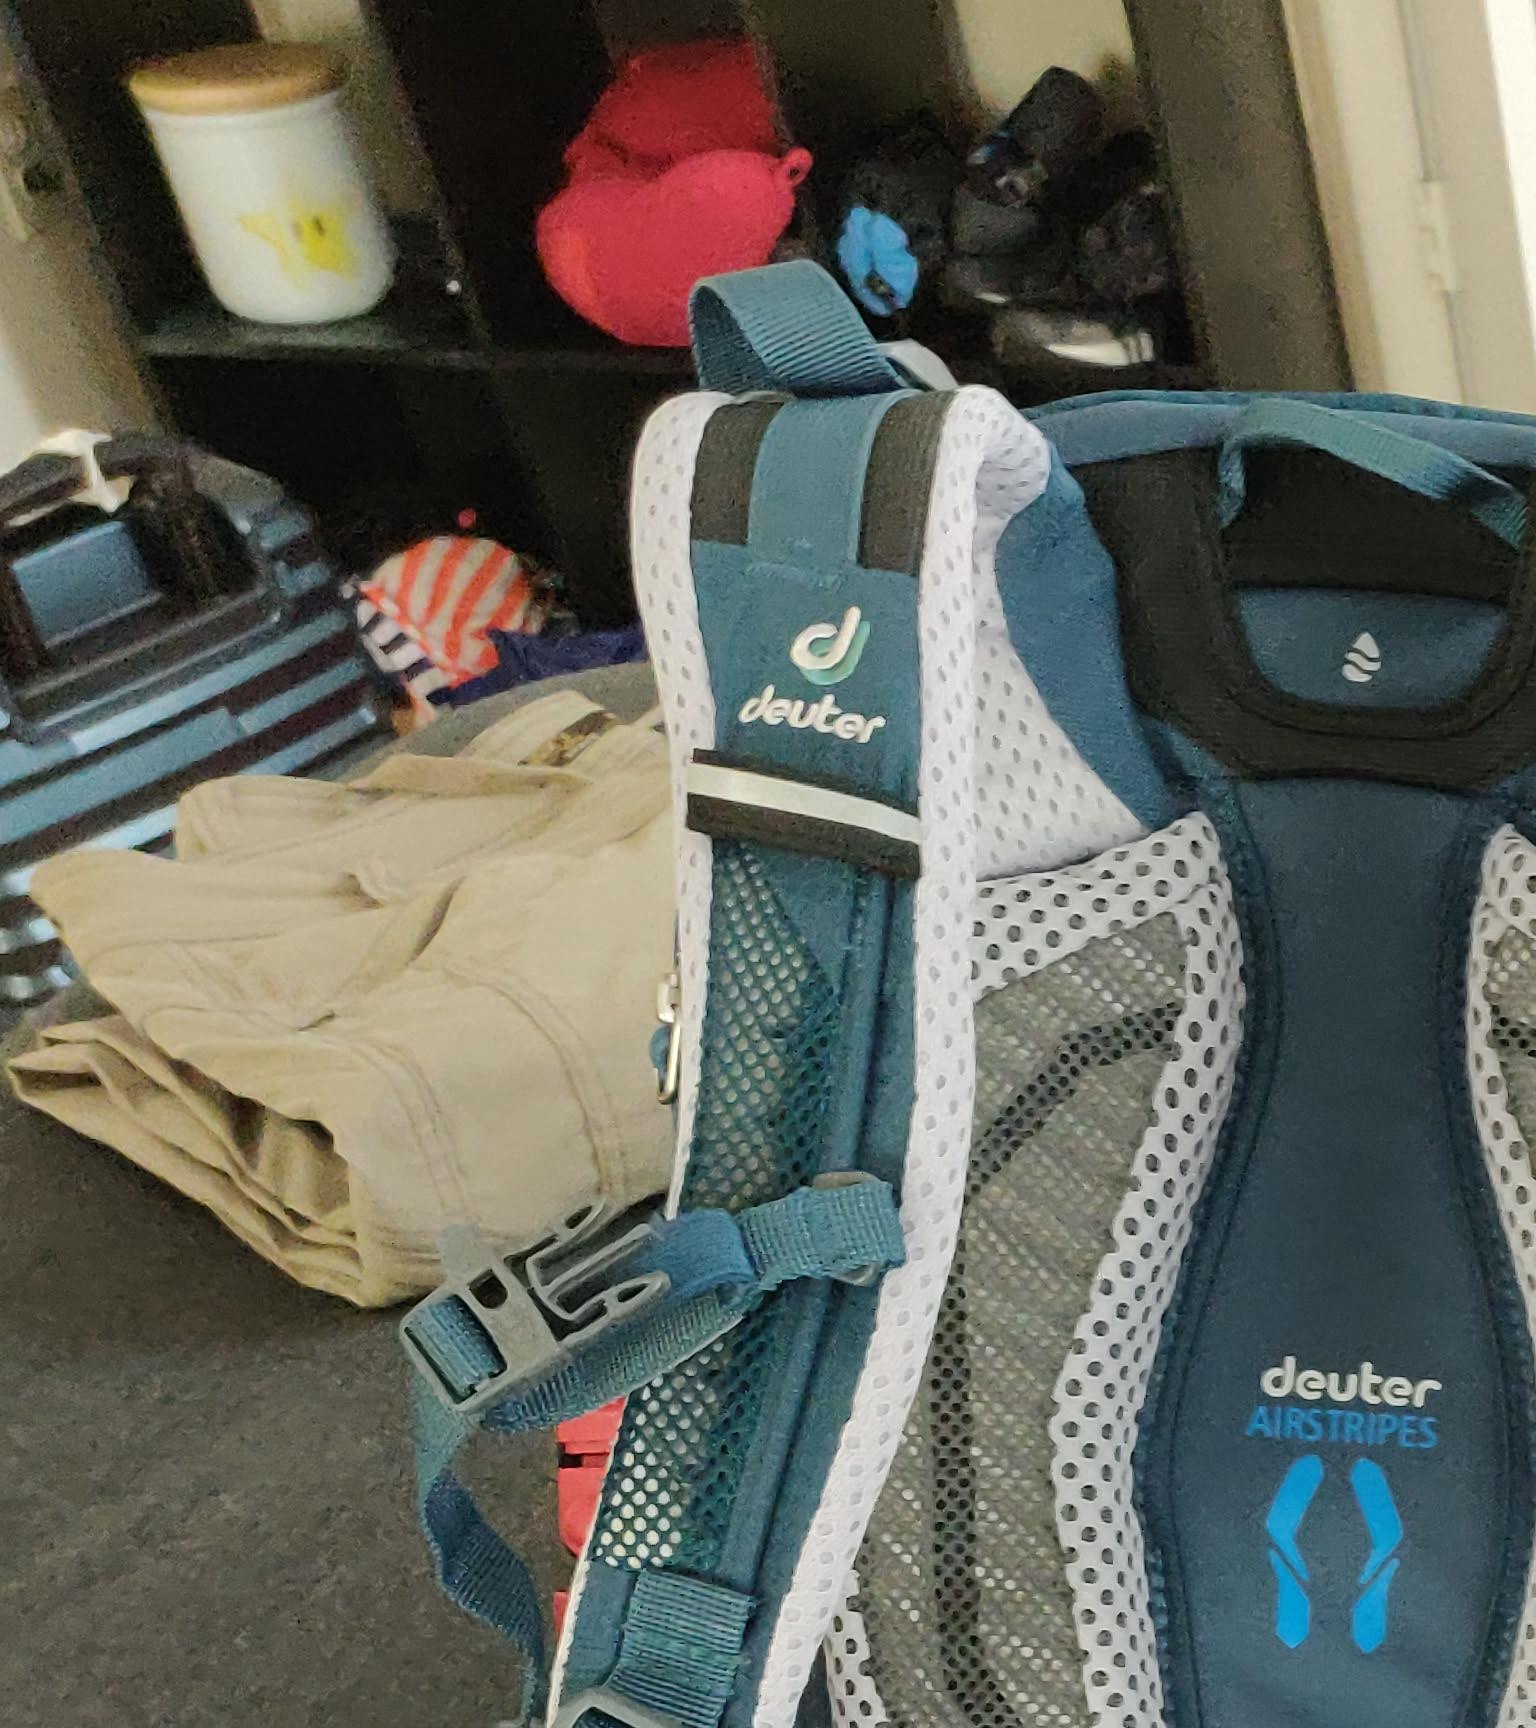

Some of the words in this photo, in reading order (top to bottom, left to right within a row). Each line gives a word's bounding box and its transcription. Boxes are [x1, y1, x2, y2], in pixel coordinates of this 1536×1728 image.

[739, 685, 886, 744] deuter
[1260, 1355, 1442, 1408] deuter
[1245, 1405, 1440, 1449] AIRSTRIPES
